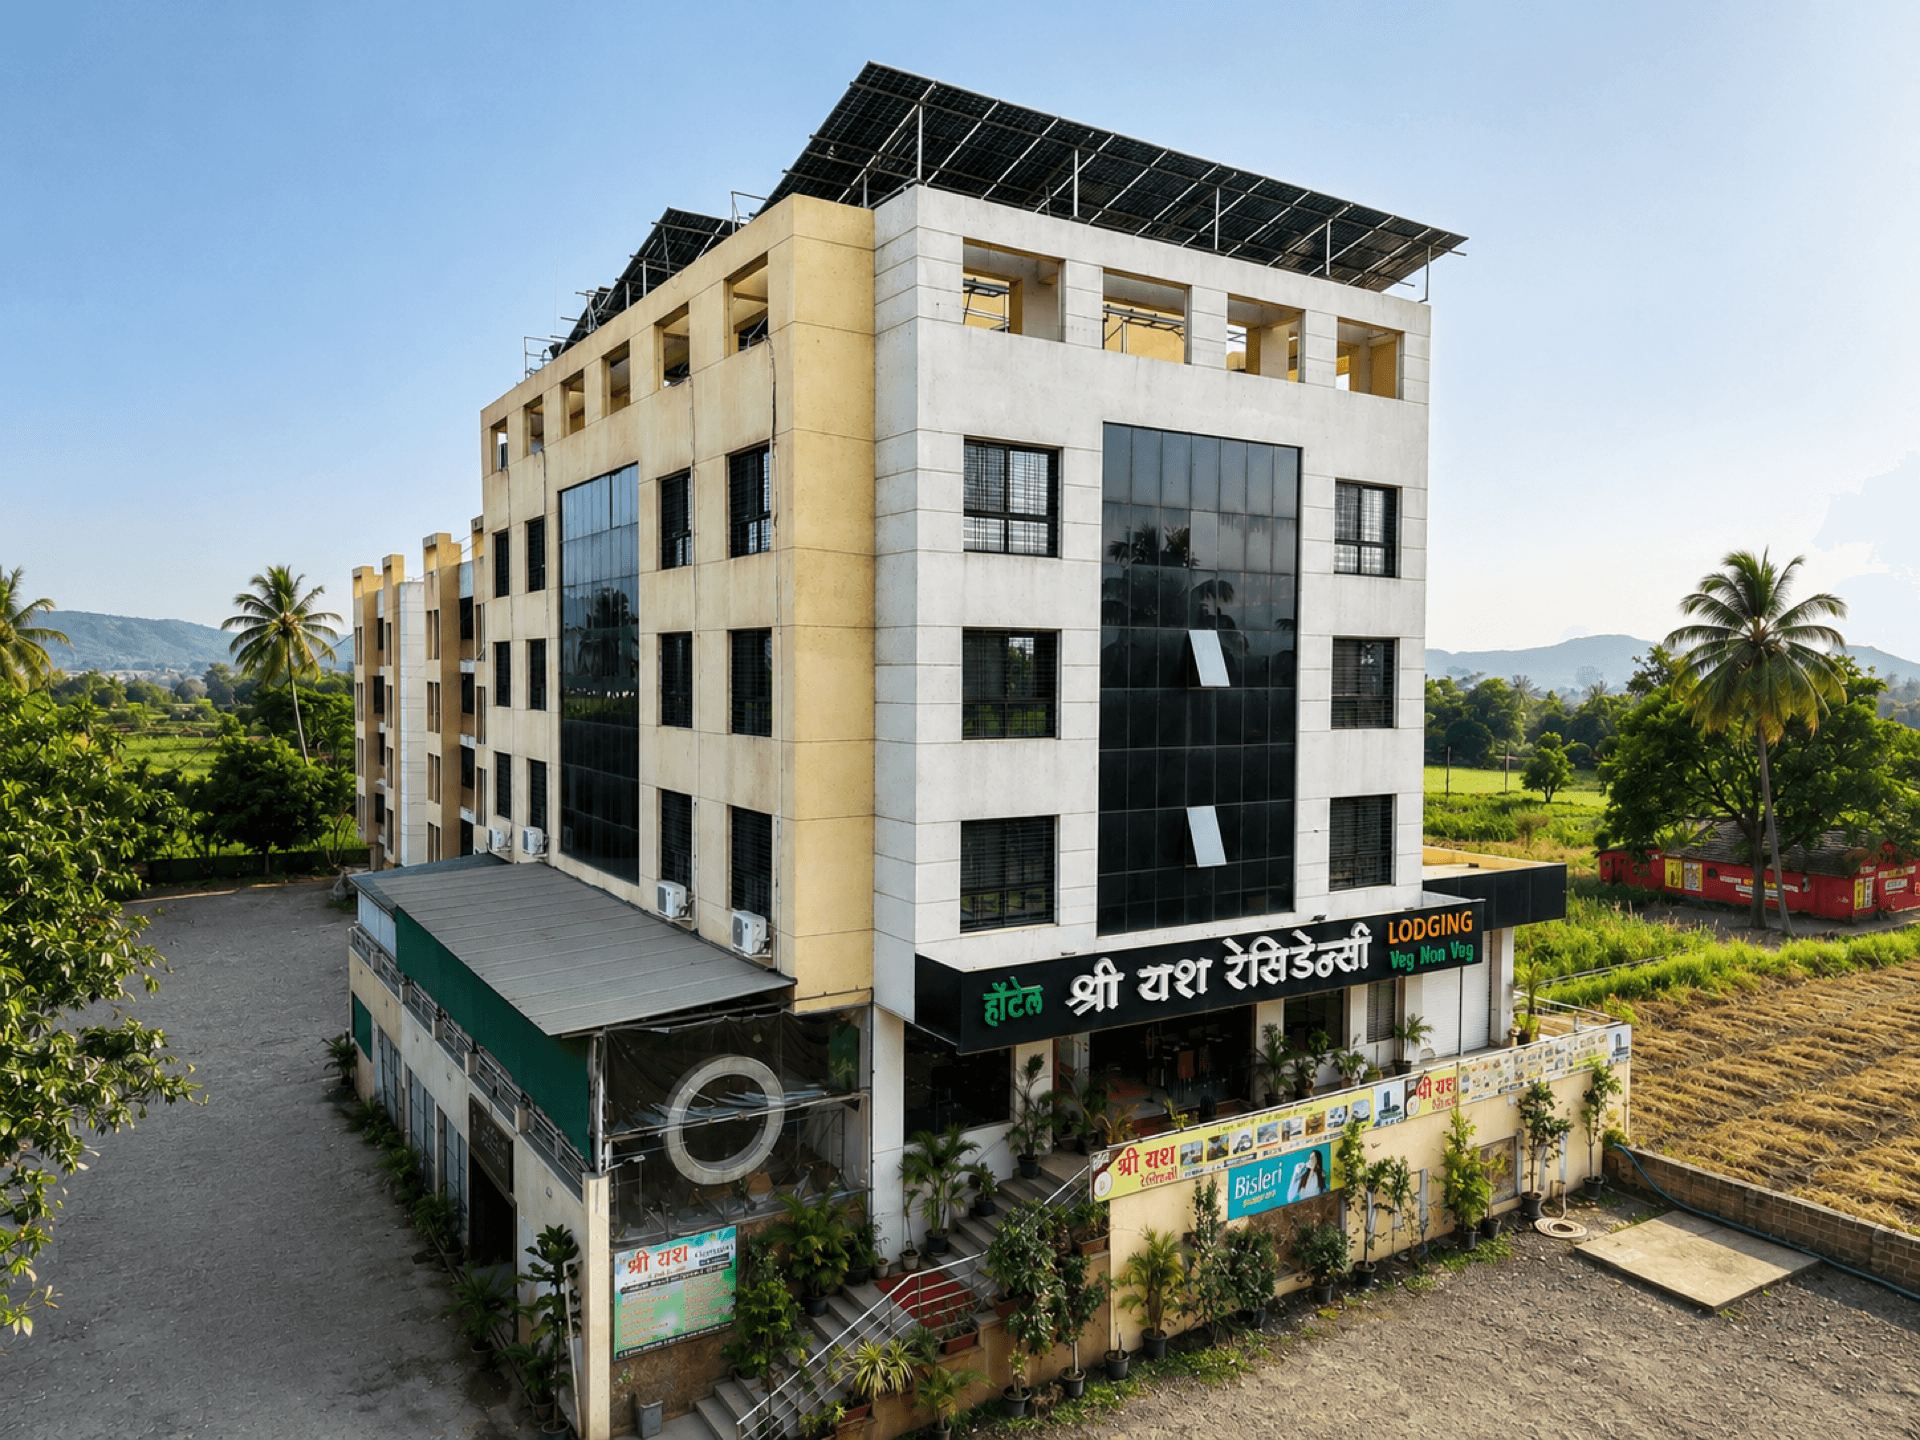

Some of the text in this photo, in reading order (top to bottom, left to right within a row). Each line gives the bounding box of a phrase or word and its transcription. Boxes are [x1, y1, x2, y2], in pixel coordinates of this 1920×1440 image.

[1388, 910, 1473, 944] LODGING
[1390, 940, 1474, 972] Veg Non Veg
[982, 922, 1373, 1027] हॉटेल श्री यश रेसिडेन्सी
[1118, 1147, 1140, 1176] श्री
[1145, 1145, 1176, 1168] यश
[1235, 1162, 1284, 1200] Bisleri
[628, 1247, 650, 1274] श्री
[657, 1244, 689, 1267] यश
